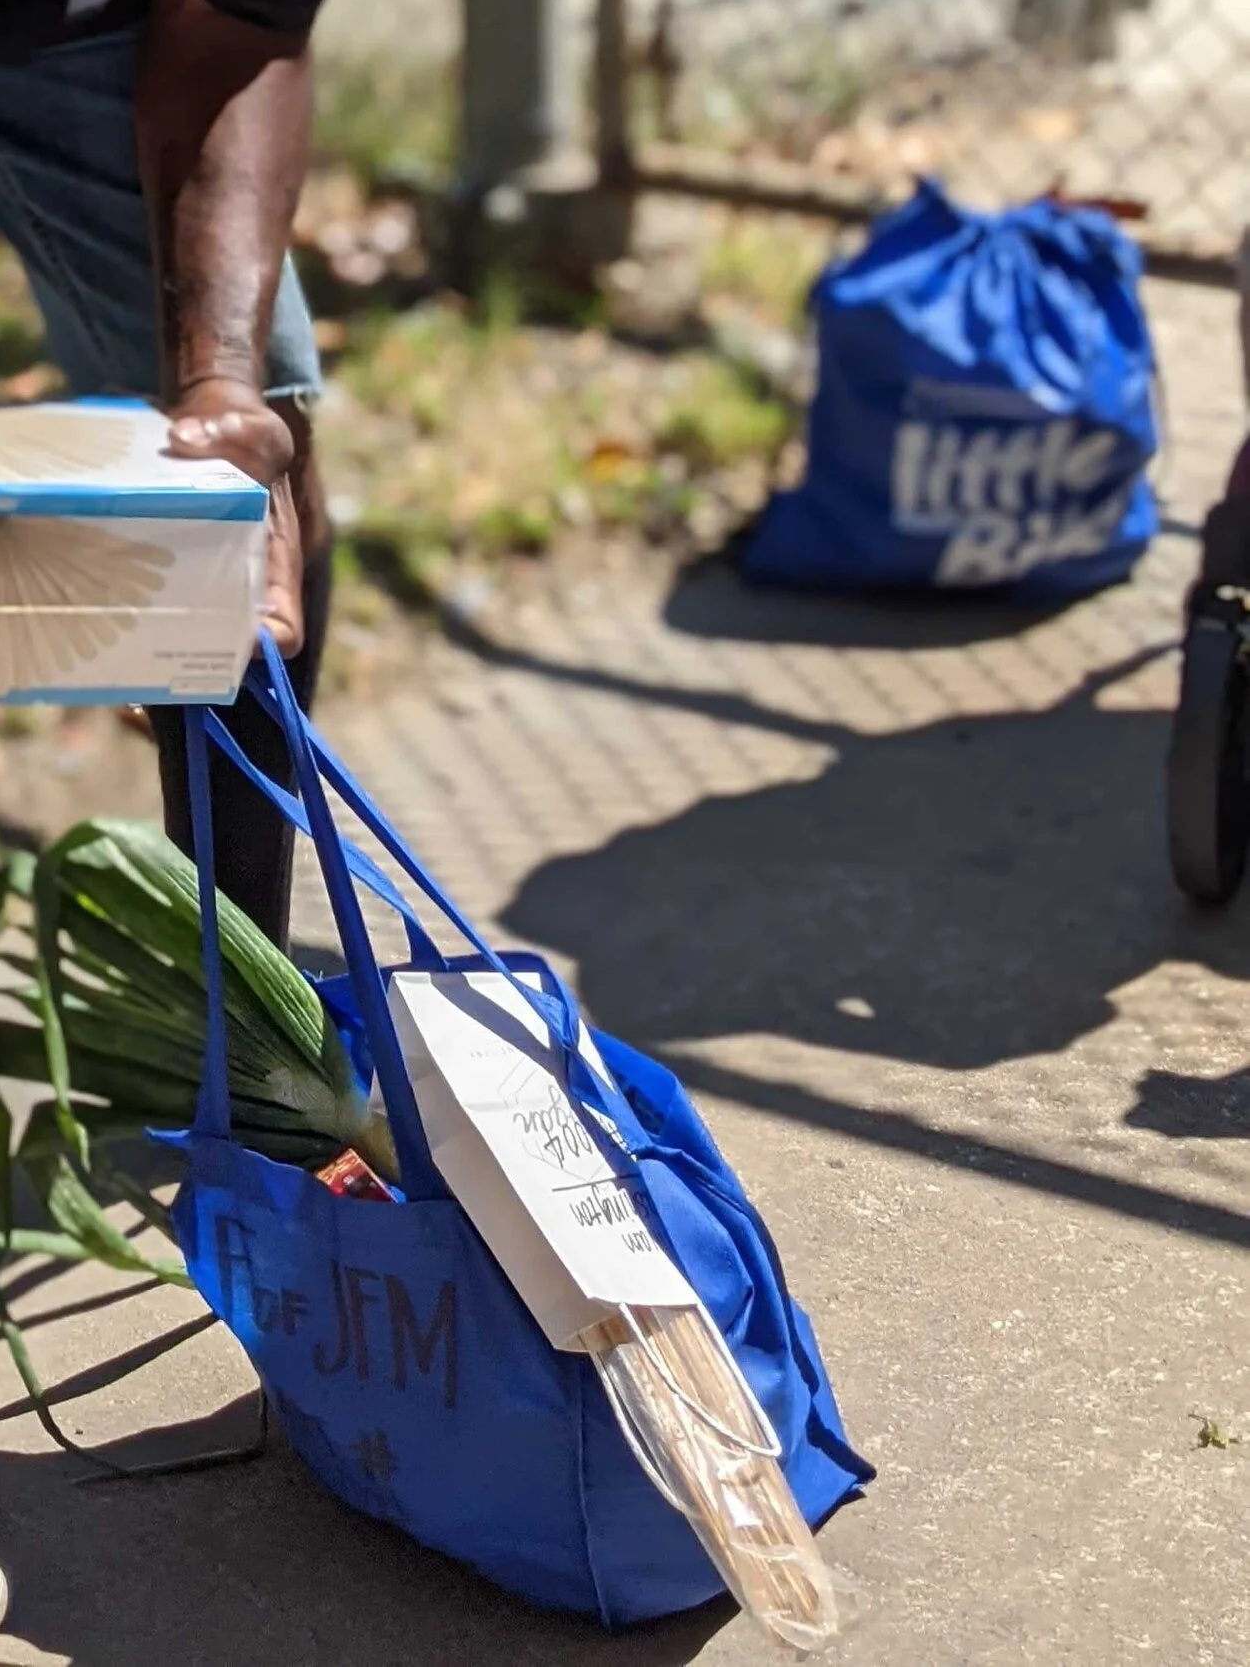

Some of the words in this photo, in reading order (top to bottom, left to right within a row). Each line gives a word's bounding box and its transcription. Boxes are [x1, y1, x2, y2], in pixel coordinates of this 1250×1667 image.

[891, 418, 1117, 535] Little
[544, 1121, 594, 1170] 004
[313, 1258, 457, 1410] JFM
